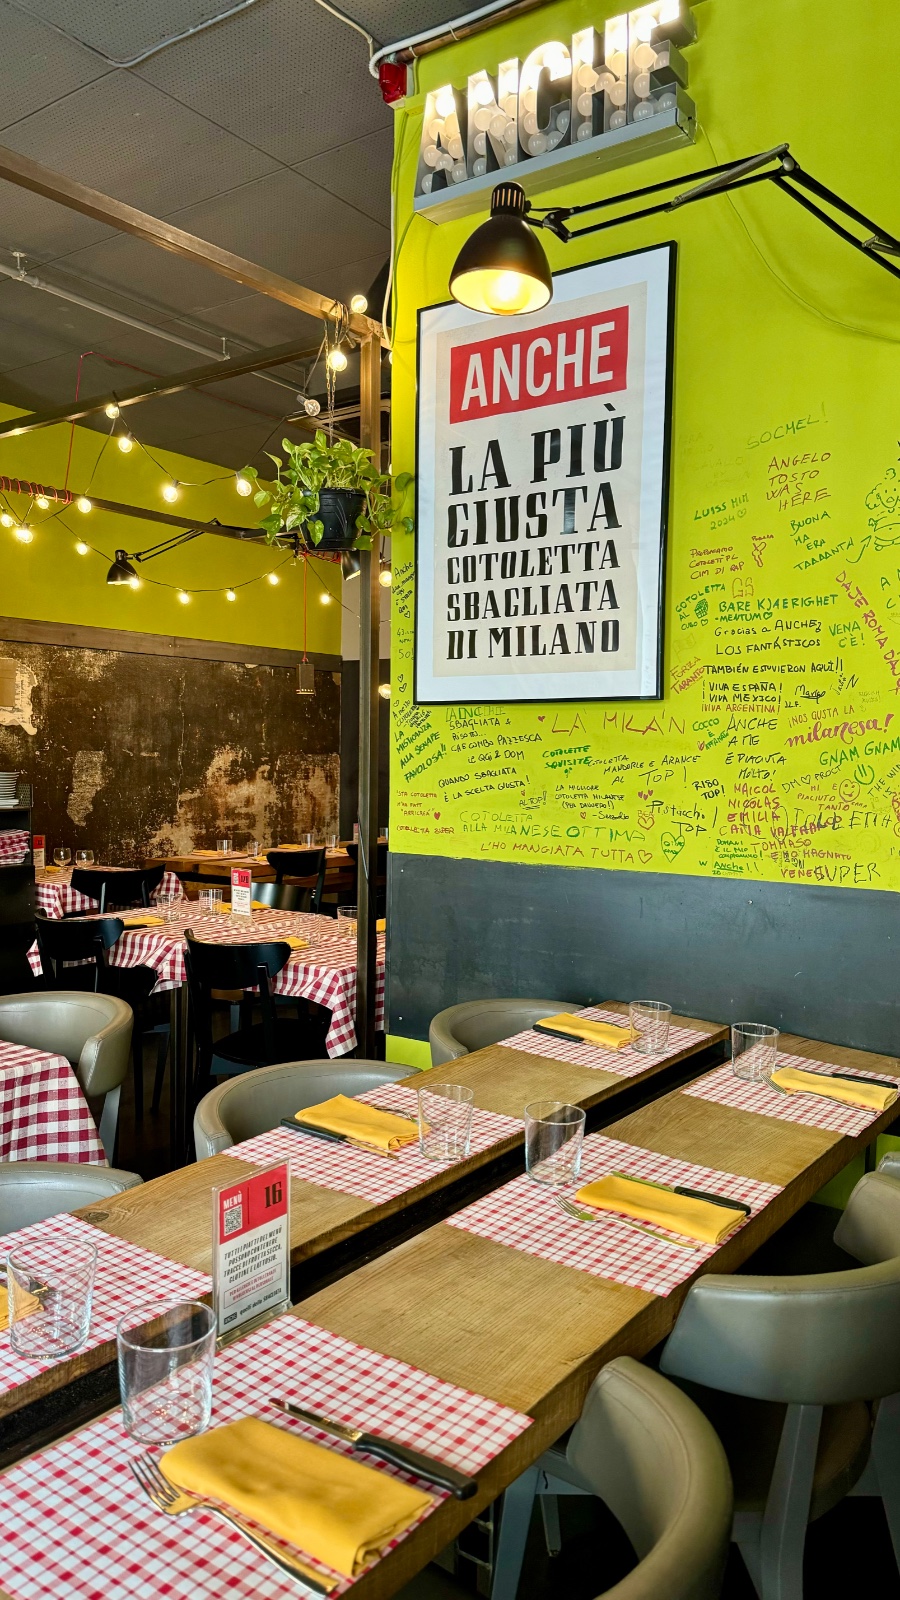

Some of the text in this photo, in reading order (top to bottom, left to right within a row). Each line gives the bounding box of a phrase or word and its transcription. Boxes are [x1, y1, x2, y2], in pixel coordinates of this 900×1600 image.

[415, 0, 694, 198] ANCHE
[461, 321, 615, 411] ANCHE
[449, 438, 511, 496] LA
[530, 403, 626, 484] PIÙ
[768, 452, 831, 473] ANGELO
[769, 470, 820, 487] TOSTO
[766, 483, 803, 501] WAS
[778, 488, 831, 512] HERE
[447, 481, 622, 548] GIUSTA
[694, 502, 727, 521] LUISS
[790, 511, 831, 536] BUONA
[447, 539, 620, 584] COTOLETTA
[447, 579, 620, 622] SBAGLIATA
[675, 584, 726, 612] COTOLETTA
[719, 601, 751, 612] BARE
[829, 621, 861, 637] VENA
[862, 610, 888, 649] ROMA
[446, 628, 477, 660] DI
[488, 619, 620, 658] MILANO
[716, 636, 820, 655] LOS FANTÁSTICOS
[703, 663, 749, 675] TAMBIÉN
[753, 664, 806, 674] ESTUVIERON
[727, 713, 778, 731] ANCHE
[812, 707, 839, 720] GUSTA
[844, 705, 854, 714] LA
[450, 717, 501, 730] SBAGLIATA
[692, 718, 720, 731] COCCO
[497, 733, 542, 745] PAZZESCA
[819, 736, 900, 766] GNAM GNAM
[438, 767, 517, 788] QUANDO SBAGLIATA
[453, 792, 463, 800] LA
[465, 785, 495, 795] SCELTA
[460, 811, 533, 823] COTOLETTA
[727, 811, 780, 823] EMILIA
[463, 824, 646, 842] ALLA MILANESE OTTIMA
[512, 843, 584, 857] MANGIATA
[591, 848, 634, 863] TUTTA
[223, 1182, 282, 1210] MENÙ 16
